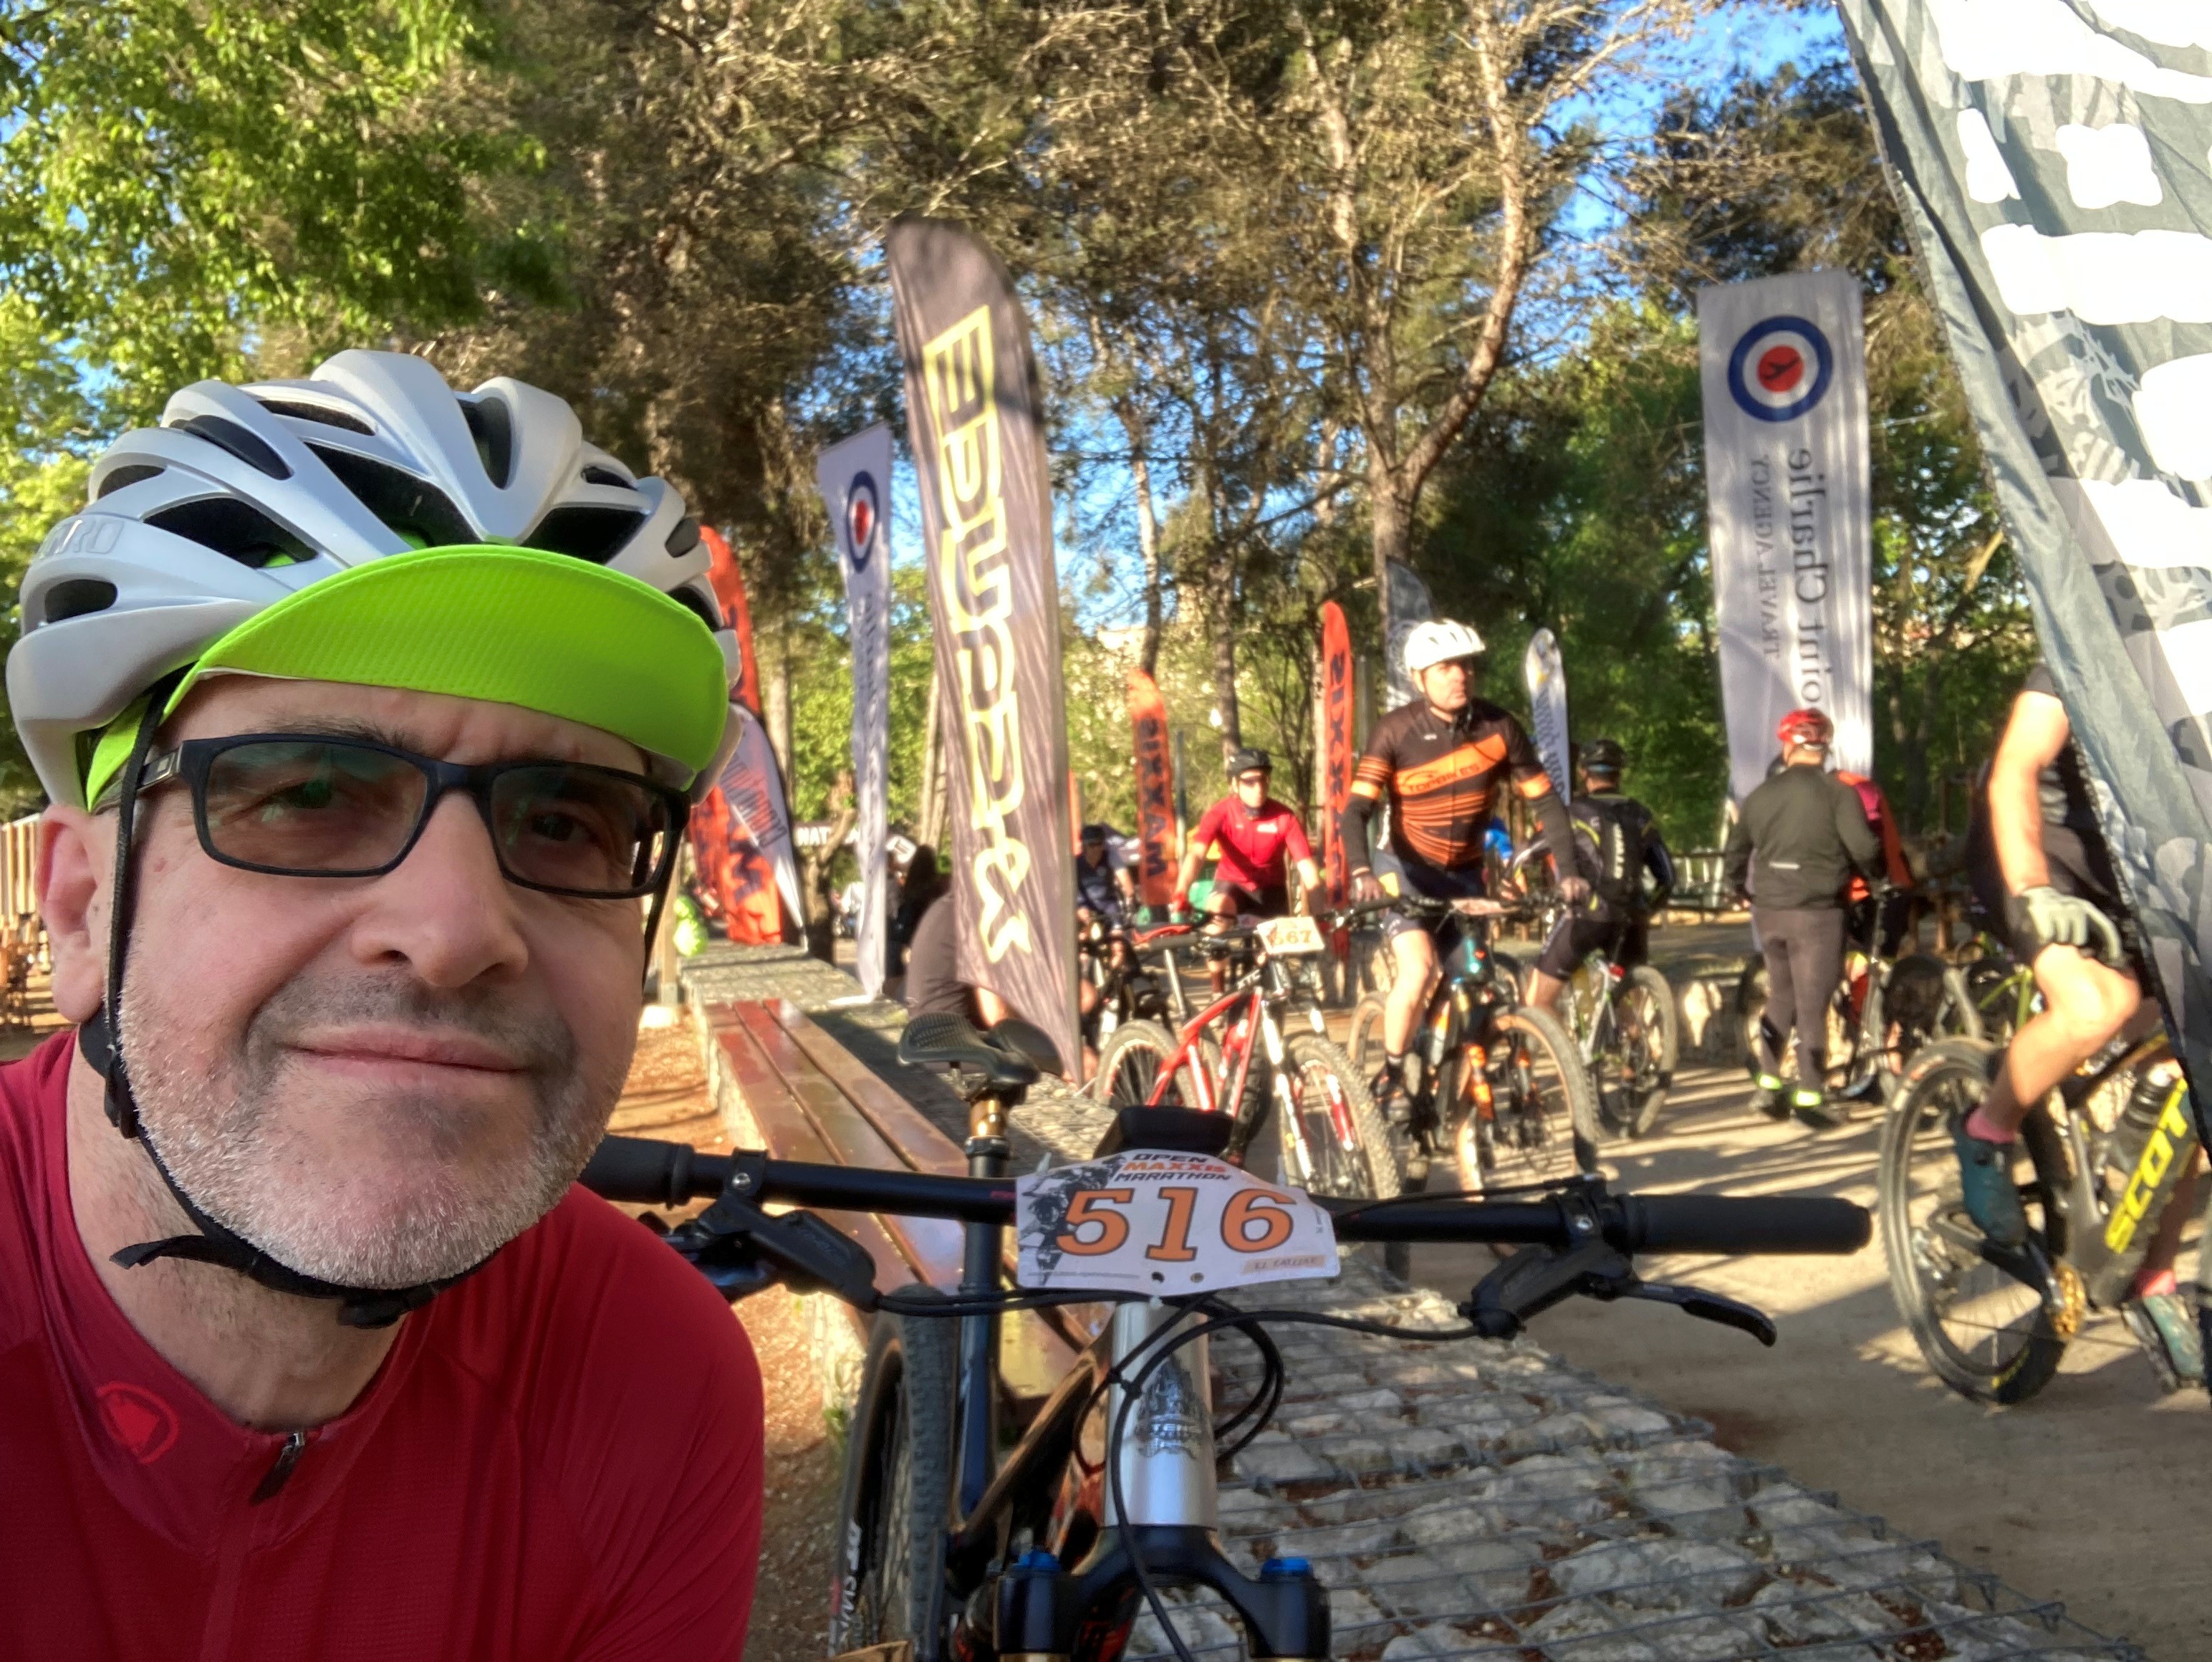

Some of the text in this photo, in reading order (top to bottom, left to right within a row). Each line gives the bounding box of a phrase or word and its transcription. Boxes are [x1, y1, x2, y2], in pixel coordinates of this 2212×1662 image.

[1133, 1153, 1208, 1163] OPEN
[1122, 1161, 1227, 1173] MAXXIS
[2104, 1076, 2189, 1254] SCOT
[1114, 1171, 1232, 1182] MARATHON
[1056, 1186, 1297, 1262] 516
